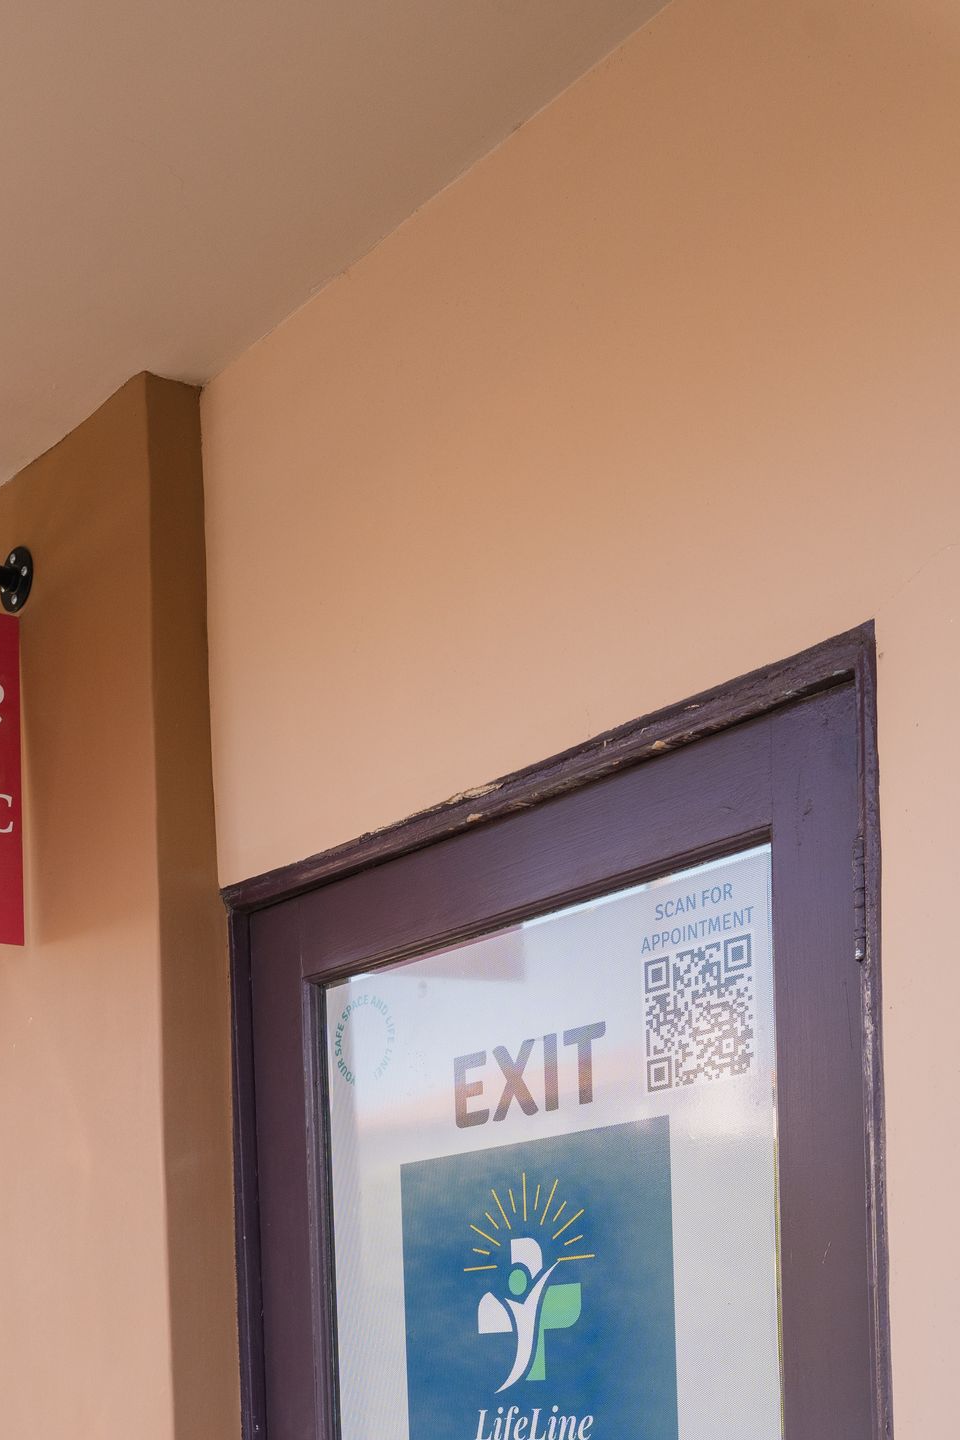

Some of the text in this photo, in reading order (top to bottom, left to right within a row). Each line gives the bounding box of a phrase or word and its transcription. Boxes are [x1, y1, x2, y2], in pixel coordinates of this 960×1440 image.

[654, 883, 734, 921] SCAN FOR
[641, 906, 754, 954] APPOINTMENT
[334, 1022, 346, 1057] SAFE
[341, 994, 369, 1022] SPACE
[370, 995, 389, 1017] AND
[453, 1020, 606, 1130] EXIT
